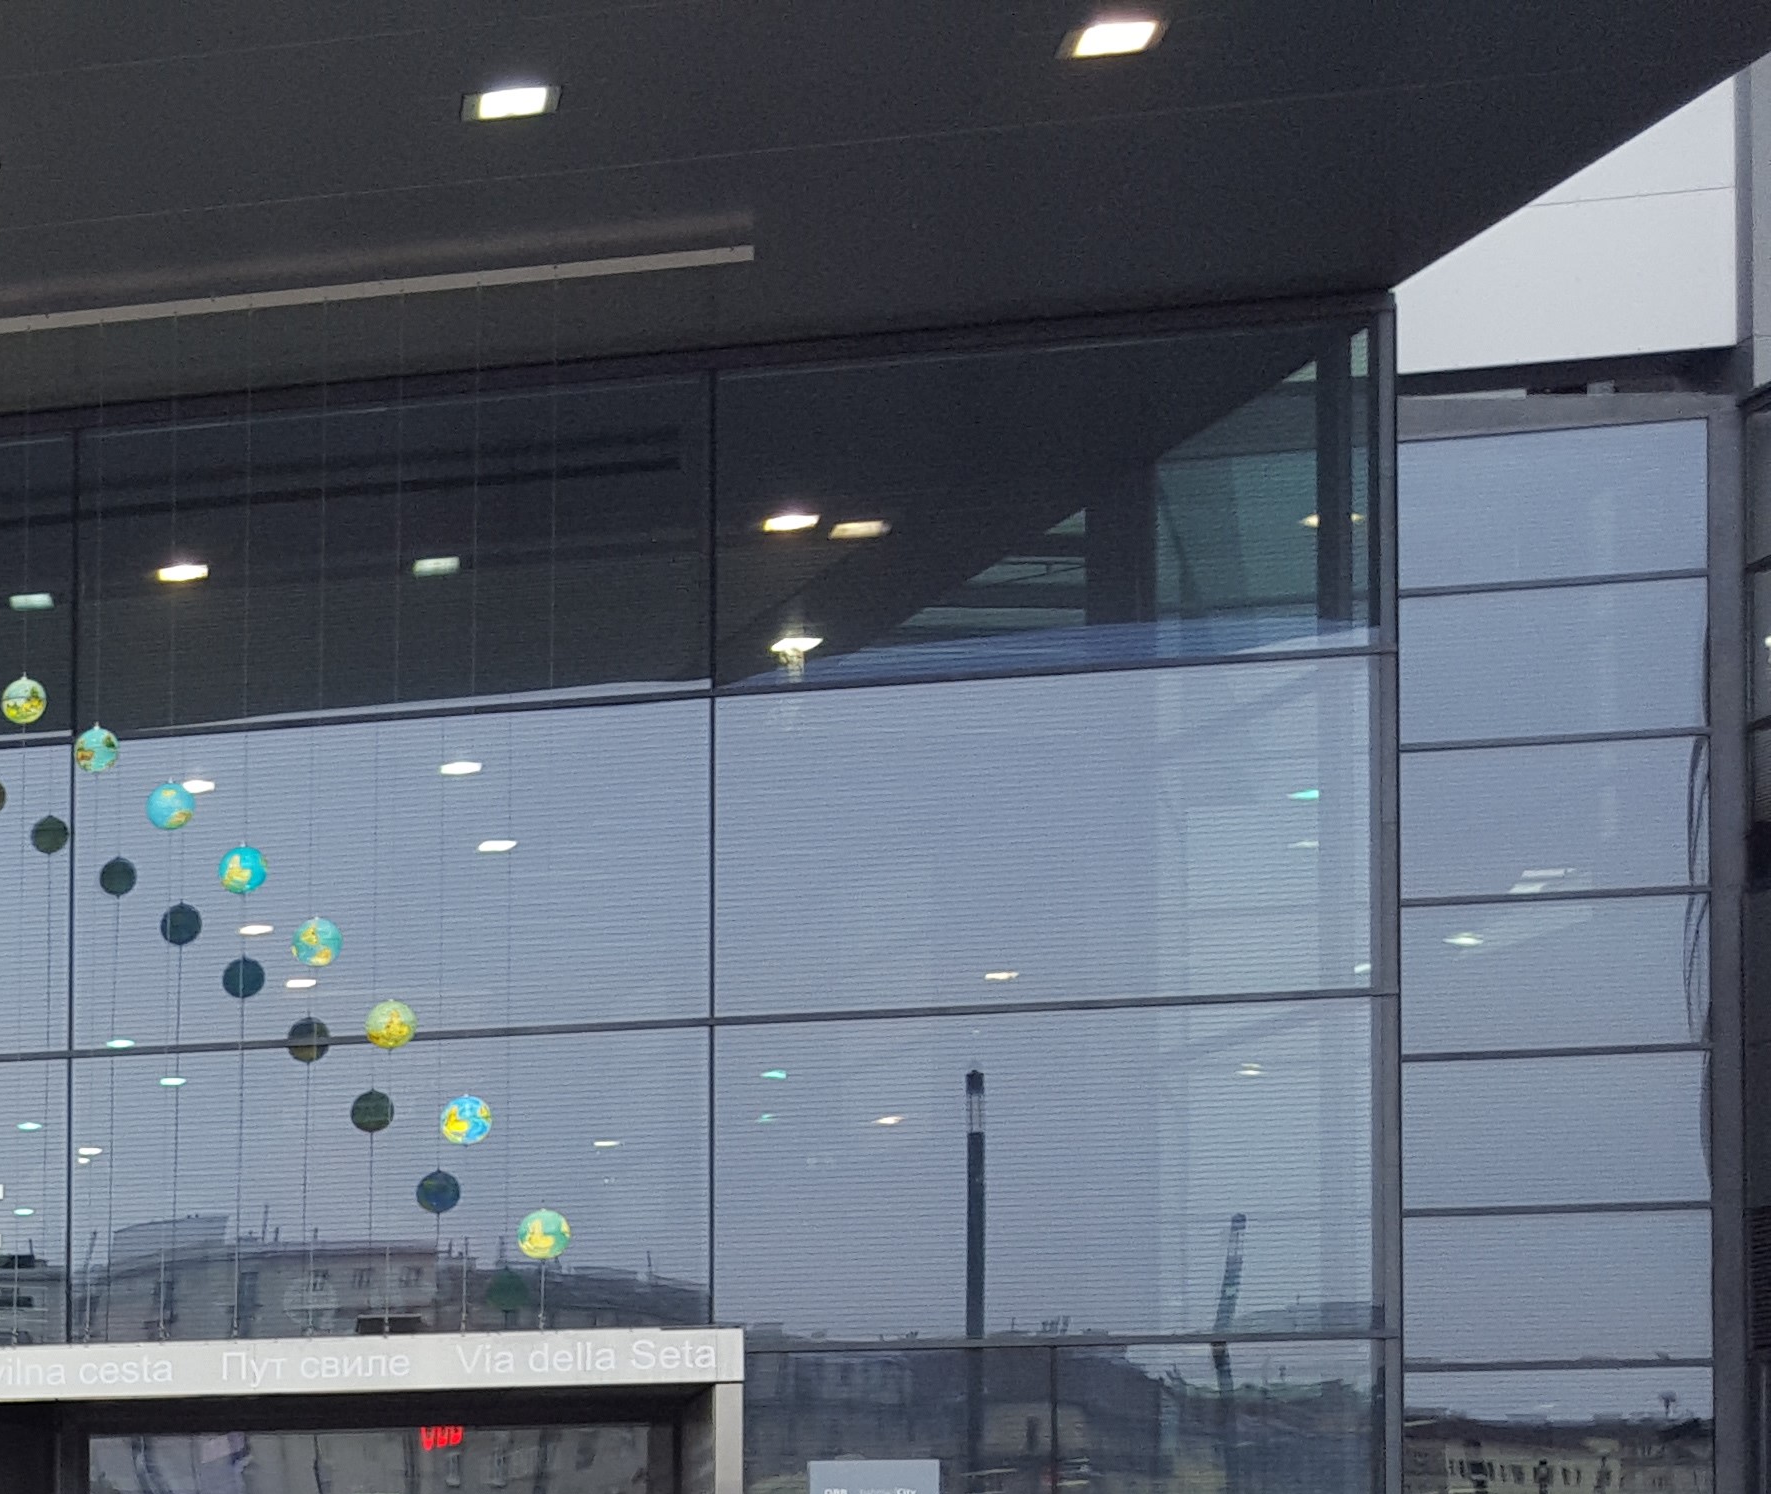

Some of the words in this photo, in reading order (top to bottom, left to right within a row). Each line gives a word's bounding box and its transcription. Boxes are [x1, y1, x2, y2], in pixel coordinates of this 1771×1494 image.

[78, 1355, 174, 1385] cesta
[220, 1350, 288, 1387] Пут
[300, 1351, 411, 1378] свиле
[456, 1344, 516, 1375] Via
[528, 1341, 617, 1372] della
[629, 1339, 718, 1370] Seta
